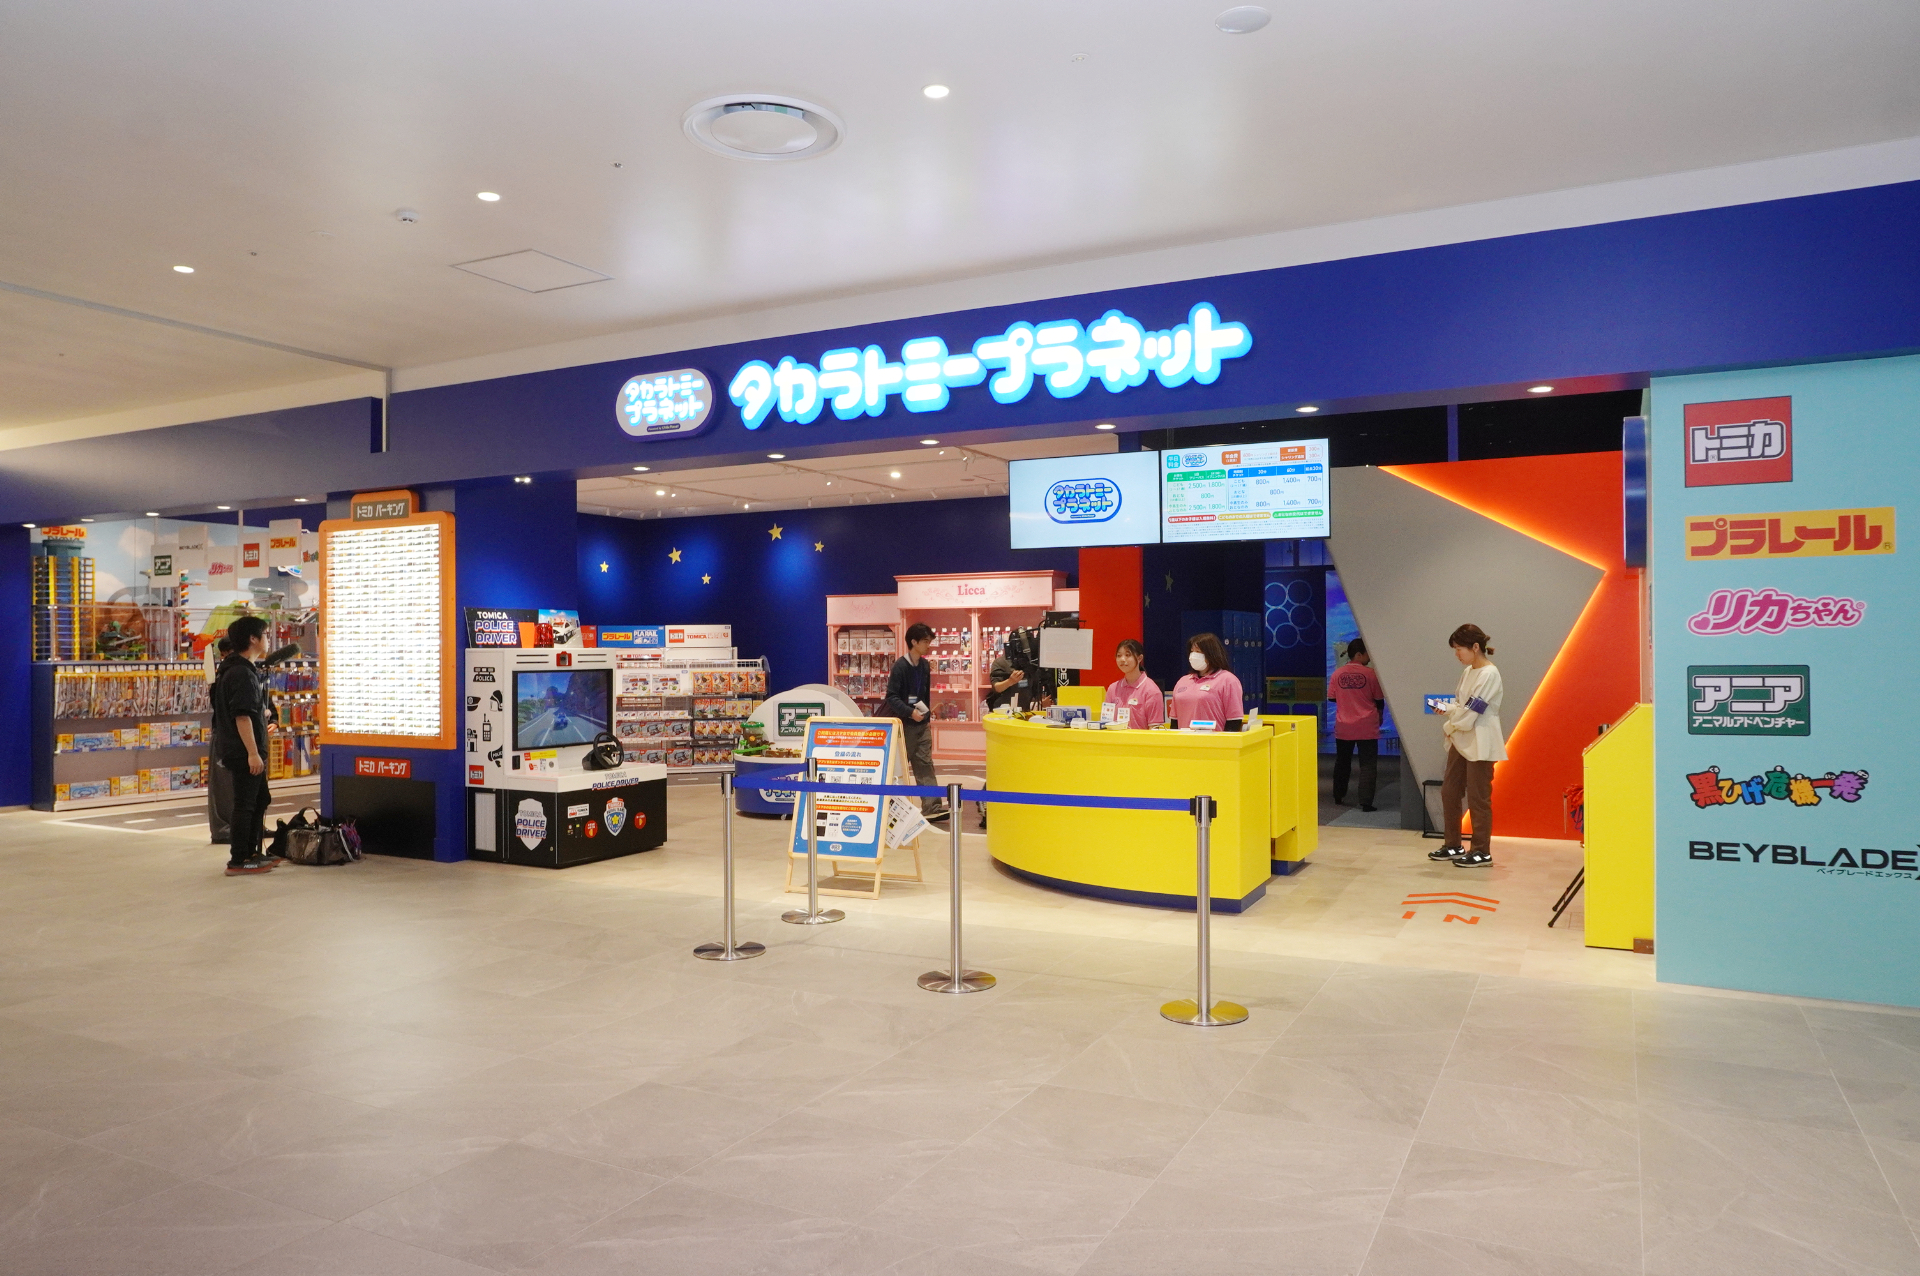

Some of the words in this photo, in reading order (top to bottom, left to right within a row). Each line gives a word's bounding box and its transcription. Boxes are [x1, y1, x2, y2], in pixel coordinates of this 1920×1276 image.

[729, 302, 1252, 429] タカラトミープラネット
[625, 373, 704, 403] タカラトミー
[625, 395, 704, 426] プラネット
[1690, 419, 1786, 464] トミカ
[1053, 483, 1113, 499] タカラトミー
[357, 505, 373, 518] トミカ
[376, 503, 405, 516] パーキング
[1053, 496, 1113, 514] プラネット
[270, 538, 296, 548] プラレール
[1690, 515, 1882, 556] プラレール
[244, 550, 259, 560] トミカ
[155, 558, 170, 569] アニア
[958, 584, 985, 595] Licca
[477, 611, 508, 620] TOMICA
[1689, 590, 1861, 634] リカちゃん
[475, 620, 514, 633] POLICE
[476, 632, 517, 645] DRIVER
[1693, 675, 1803, 714] アニア
[781, 708, 822, 726] アニア
[1692, 716, 1804, 728] アニマルアドベンチャー
[359, 760, 375, 773] トミカ
[378, 761, 407, 775] パーキング
[592, 781, 615, 791] POLICE
[615, 778, 639, 787] DRIVER
[1686, 770, 1868, 808] 黒ひげ危機一発
[517, 819, 545, 829] POLICE
[516, 828, 546, 839] DRIVER
[1689, 841, 1918, 871] BEYBLADE
[1817, 868, 1912, 879] ベイブレードエックス
